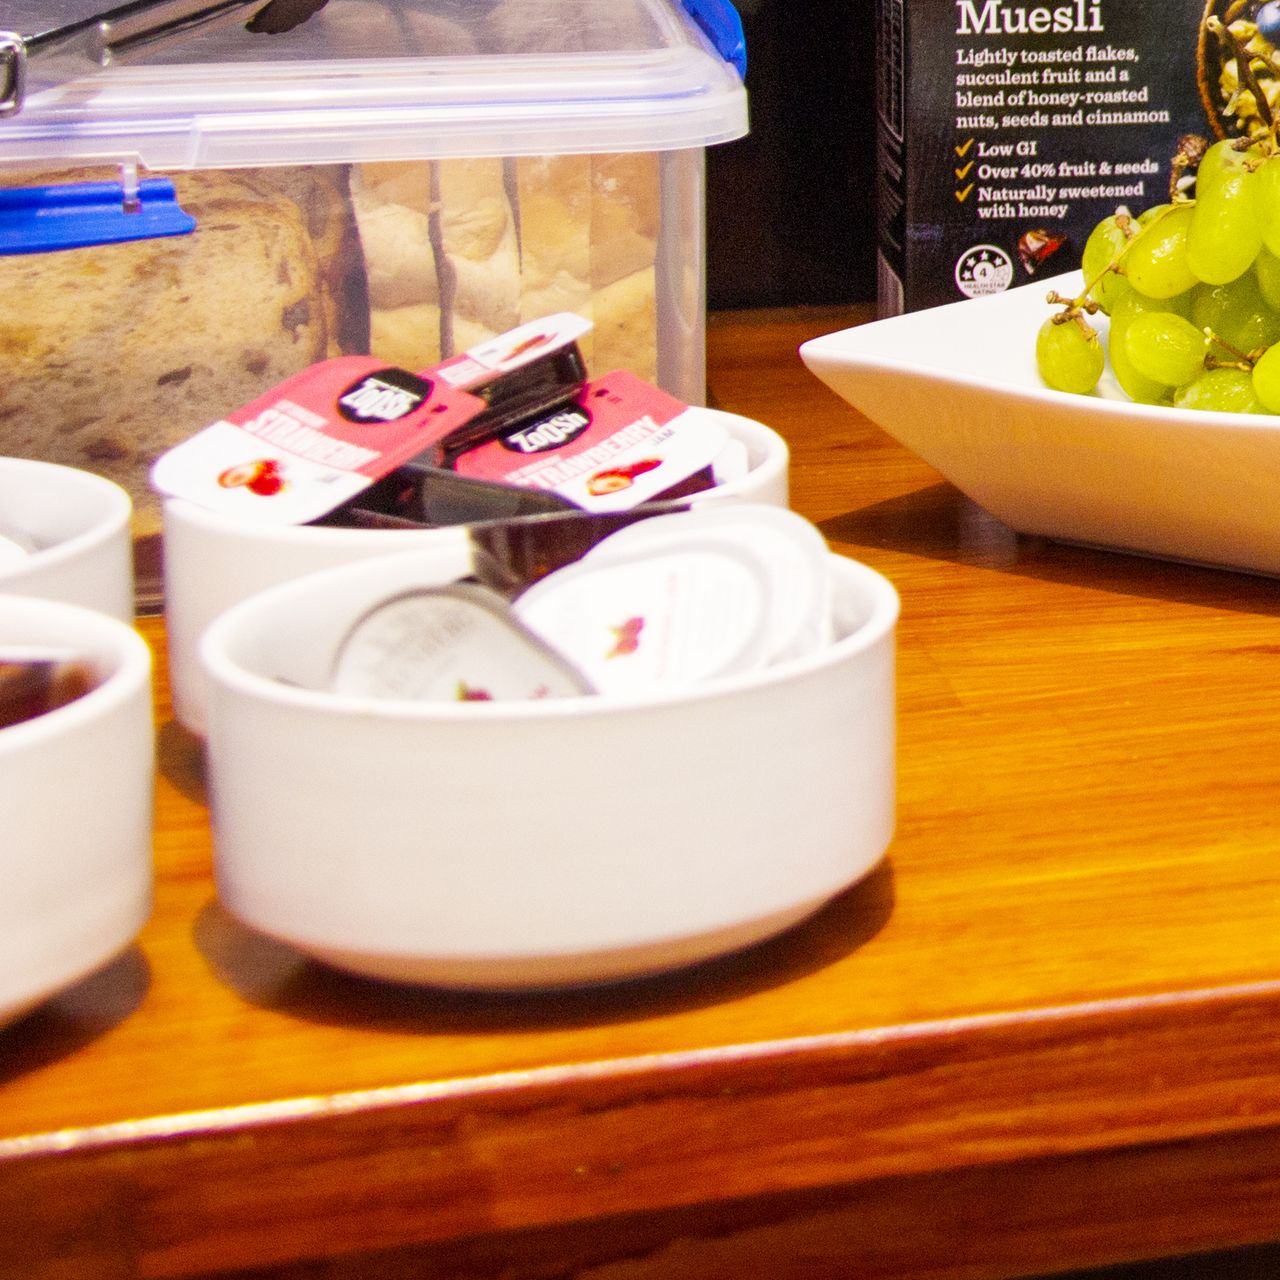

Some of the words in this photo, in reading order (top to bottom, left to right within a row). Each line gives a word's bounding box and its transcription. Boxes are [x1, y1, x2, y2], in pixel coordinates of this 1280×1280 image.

[956, 48, 1017, 70] Lightly
[1021, 48, 1082, 64] toasted
[1086, 46, 1139, 63] flakes,
[956, 70, 1039, 88] succulent
[1042, 68, 1081, 85] fruit
[1085, 67, 1116, 83] and
[1119, 71, 1129, 83] a
[956, 90, 1005, 108] blend
[1008, 89, 1026, 107] of
[1026, 87, 1148, 109] honey-roasted
[956, 114, 999, 131] nuts,
[1002, 111, 1049, 128] seeds
[1052, 110, 1083, 126] and
[1086, 108, 1170, 125] cinnamon
[978, 142, 1013, 157] Low
[1016, 140, 1037, 156] GI
[978, 165, 1018, 181] Over
[1021, 163, 1056, 179] 40%
[1059, 161, 1096, 178] fruit
[1098, 161, 1112, 177] &
[1115, 159, 1159, 176] seeds
[978, 184, 1056, 208] Naturally
[1059, 181, 1144, 200] sweetened
[978, 202, 1014, 219] with
[1018, 200, 1068, 219] honey
[979, 267, 987, 278] 4
